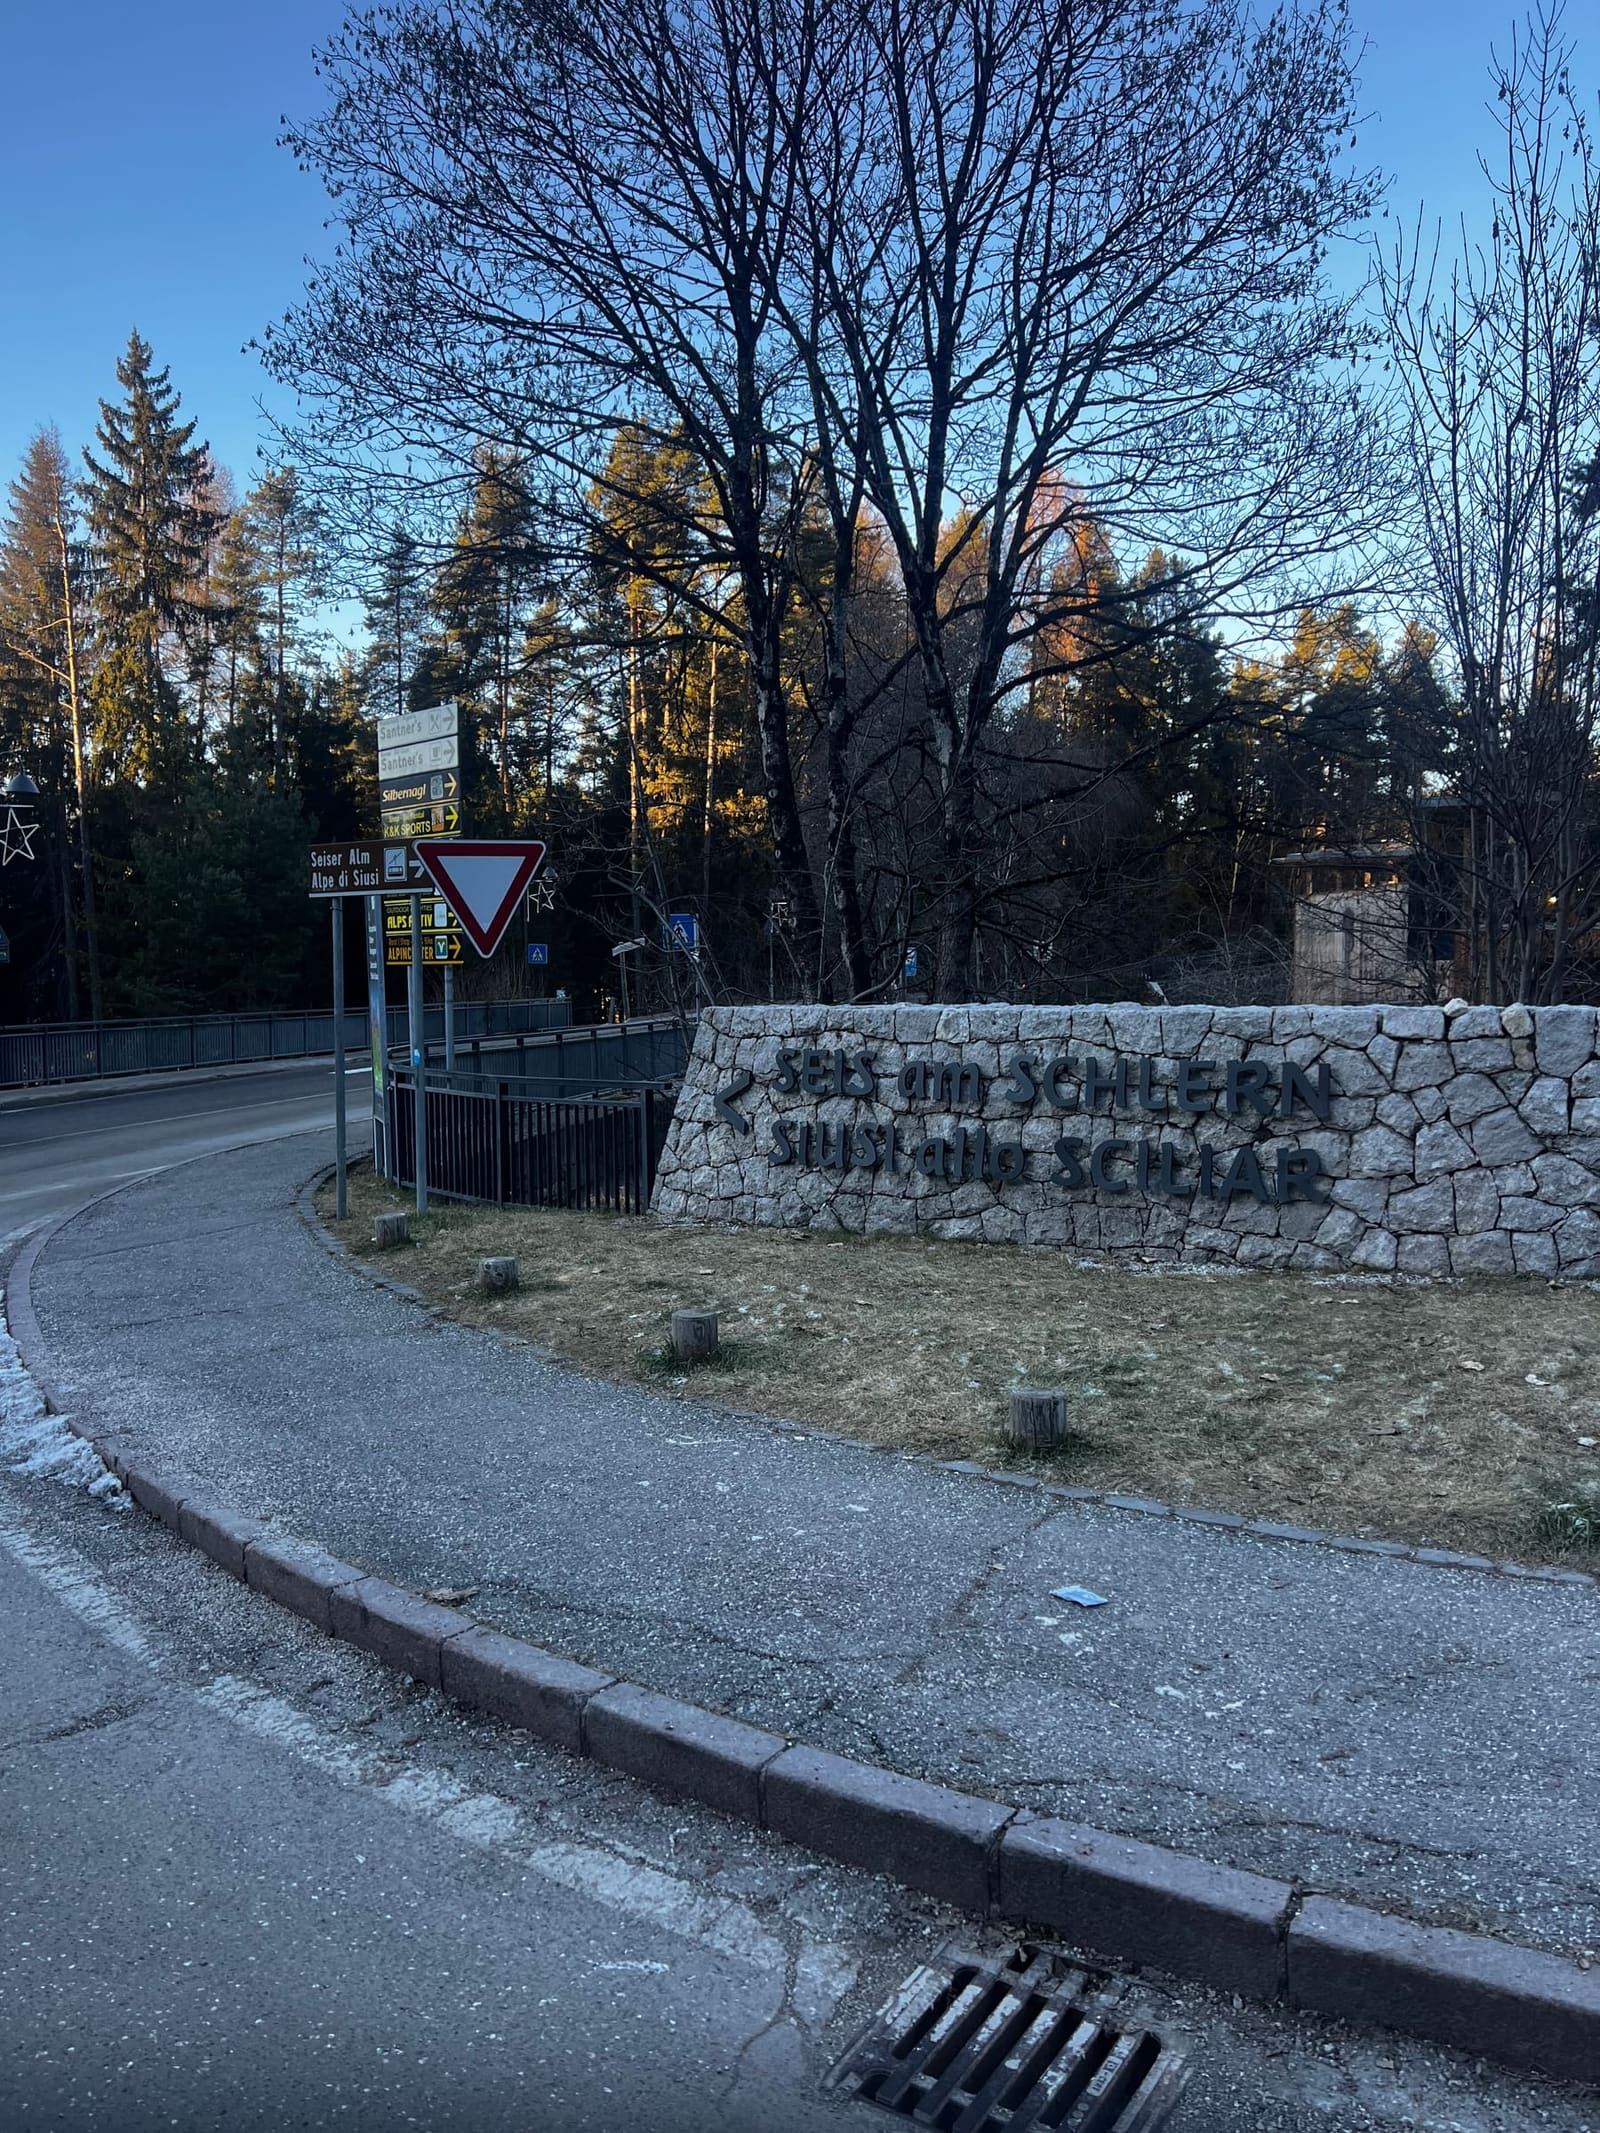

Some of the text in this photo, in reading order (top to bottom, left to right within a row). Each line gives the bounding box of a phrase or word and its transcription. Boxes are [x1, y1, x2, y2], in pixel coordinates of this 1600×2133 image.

[380, 719, 422, 740] Santner's
[381, 752, 423, 771] Santner's
[382, 783, 426, 802] Silbernagl
[384, 821, 431, 838] K&K SPORTS
[311, 848, 370, 868] Seiser Alm
[312, 868, 379, 891] Alpe di Siusi
[387, 916, 407, 928] ALPS
[772, 1048, 1330, 1121] SEIS am SCHLERN
[768, 1119, 1322, 1204] SIUSI allo SCILIAR
